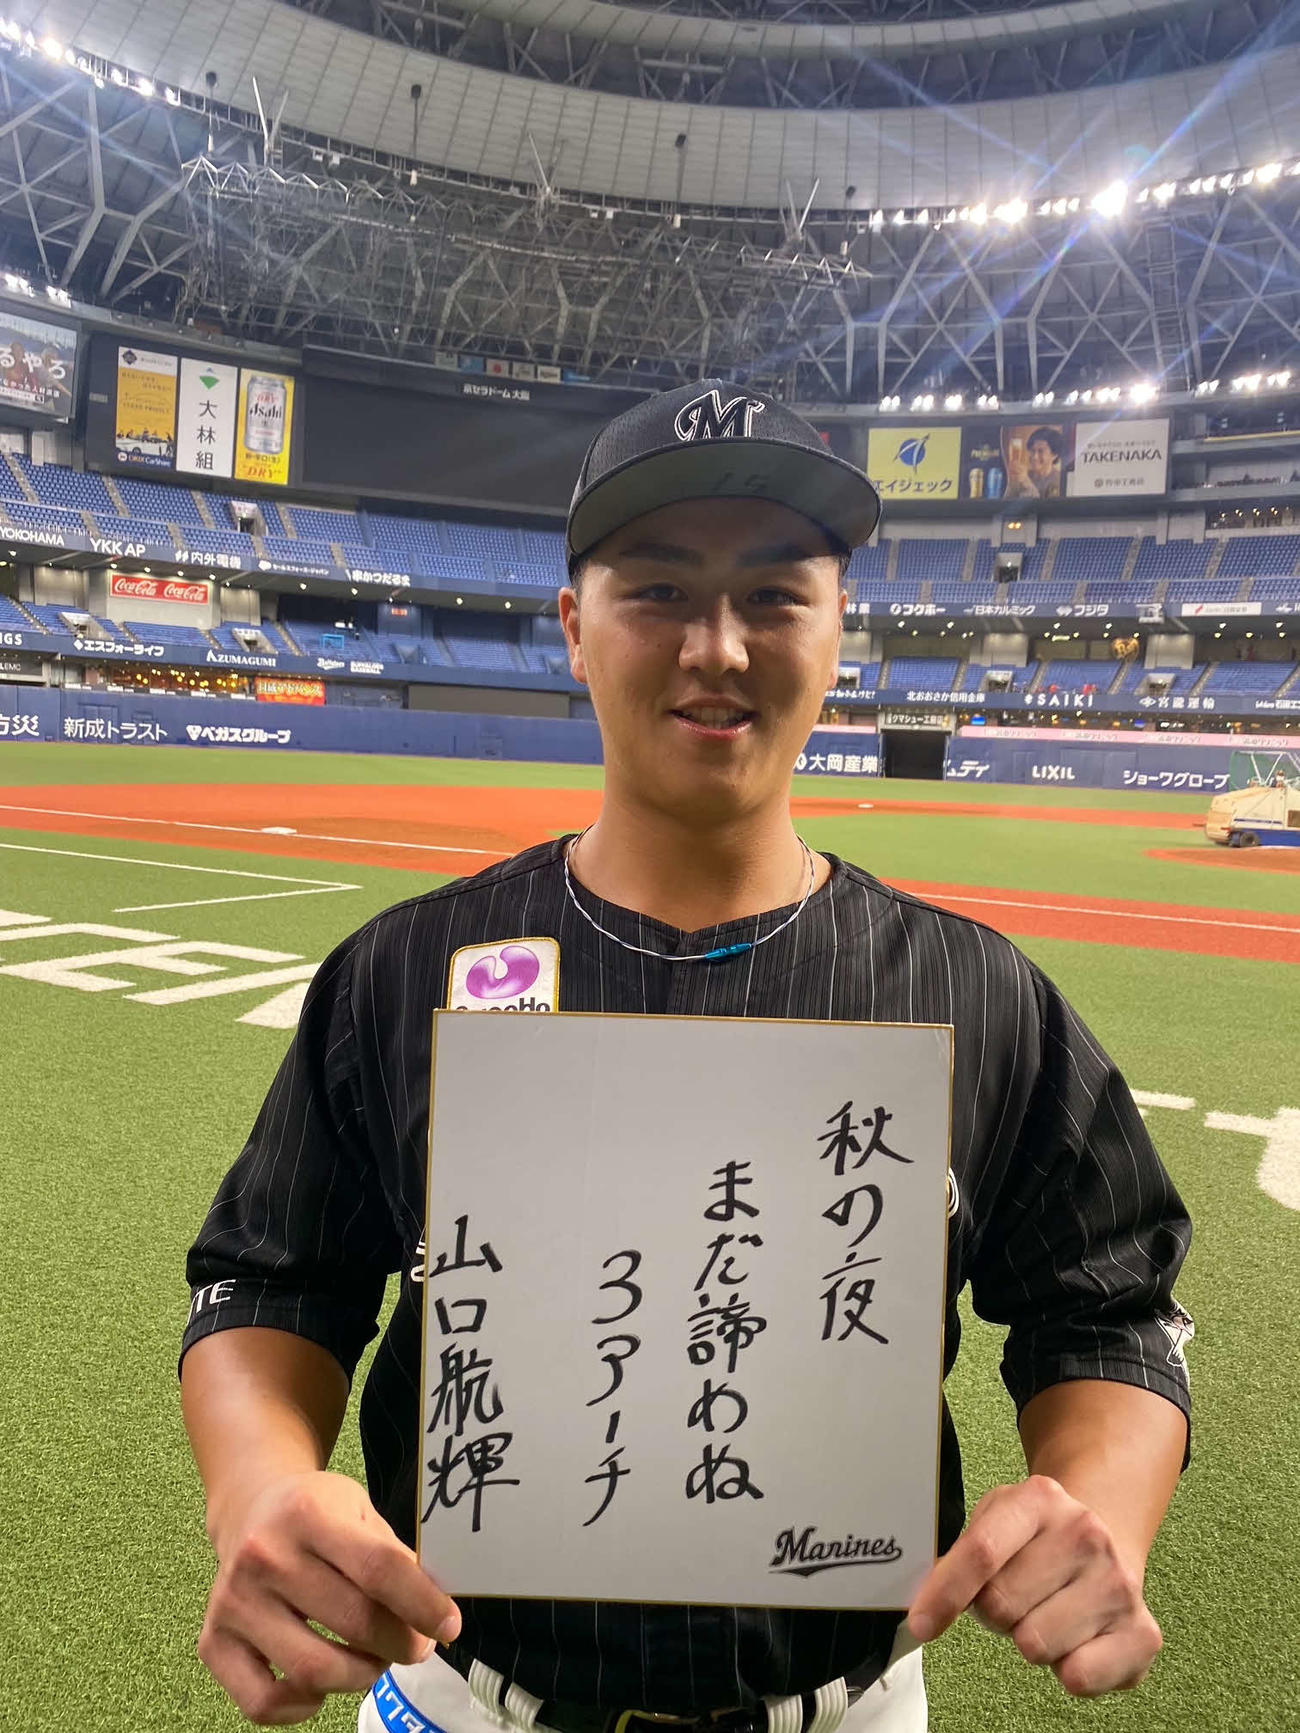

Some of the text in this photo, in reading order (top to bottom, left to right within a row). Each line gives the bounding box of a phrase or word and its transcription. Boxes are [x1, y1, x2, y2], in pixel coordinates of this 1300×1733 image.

[194, 399, 218, 471] 大林組
[1082, 448, 1162, 464] TAKENAKA
[875, 479, 953, 494] エイジェック
[0, 526, 65, 547] YOKOHAMA
[90, 538, 146, 558] YKK AP
[1073, 604, 1109, 617] フジタ
[84, 640, 165, 657] エスフォーライフ
[206, 649, 277, 668] AZUMAGUMI
[1037, 693, 1094, 708] SAIKI
[64, 716, 168, 741] 新成トラスト
[201, 727, 291, 744] ベガスグループ
[808, 753, 878, 773] 大岡産業
[1032, 764, 1075, 781] LIXIL
[1122, 769, 1230, 790] ショーワグローブ
[816, 1100, 914, 1345] 秋の夜
[685, 1160, 767, 1504] まだ諦めぬ
[420, 1215, 520, 1532] 山口航輝
[768, 1525, 903, 1576] Marines
